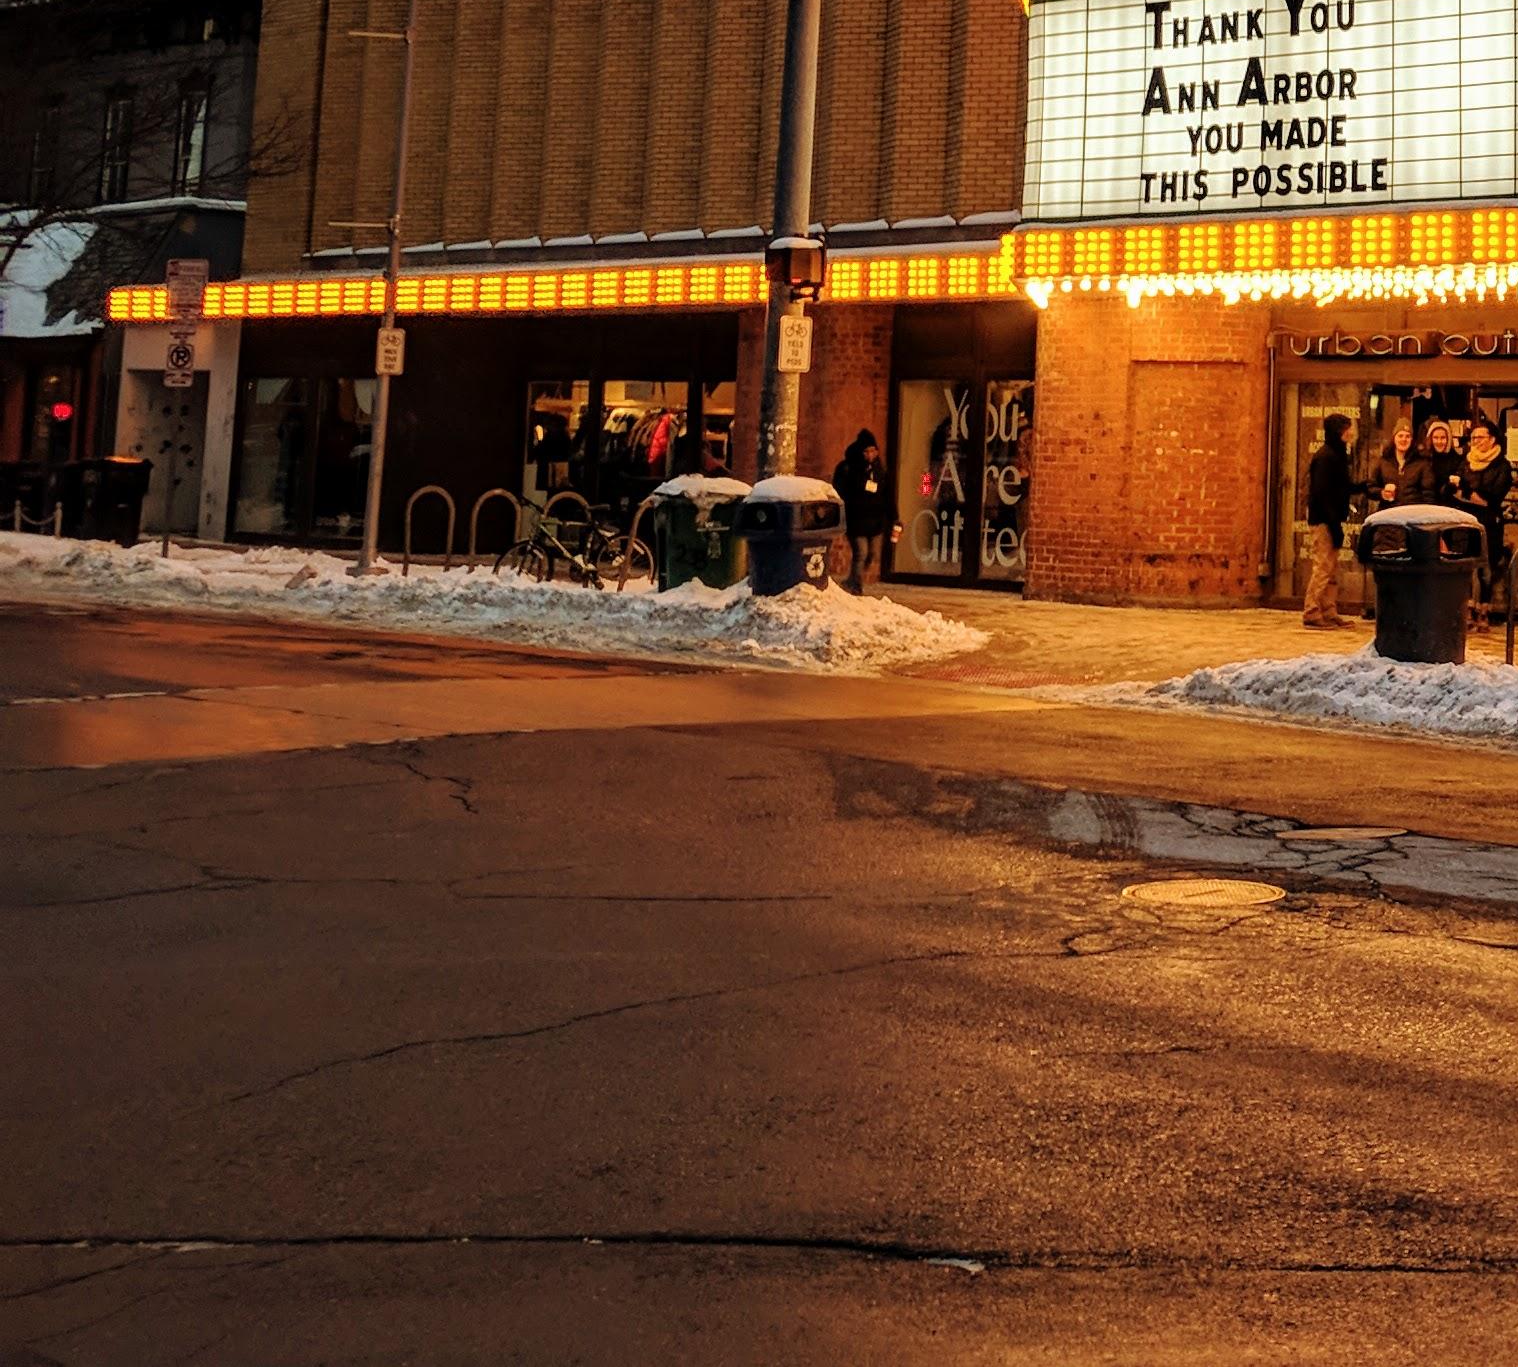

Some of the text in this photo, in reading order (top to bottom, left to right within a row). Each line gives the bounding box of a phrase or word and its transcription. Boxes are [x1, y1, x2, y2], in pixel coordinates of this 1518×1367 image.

[1145, 0, 1265, 51] THANK
[1142, 56, 1359, 117] ANN ARBOR
[1187, 114, 1347, 157] YOU MADE
[1140, 157, 1389, 204] THIS POSSIBLE
[1290, 332, 1421, 356] urban
[944, 388, 1020, 443] You
[933, 450, 1022, 505] Are
